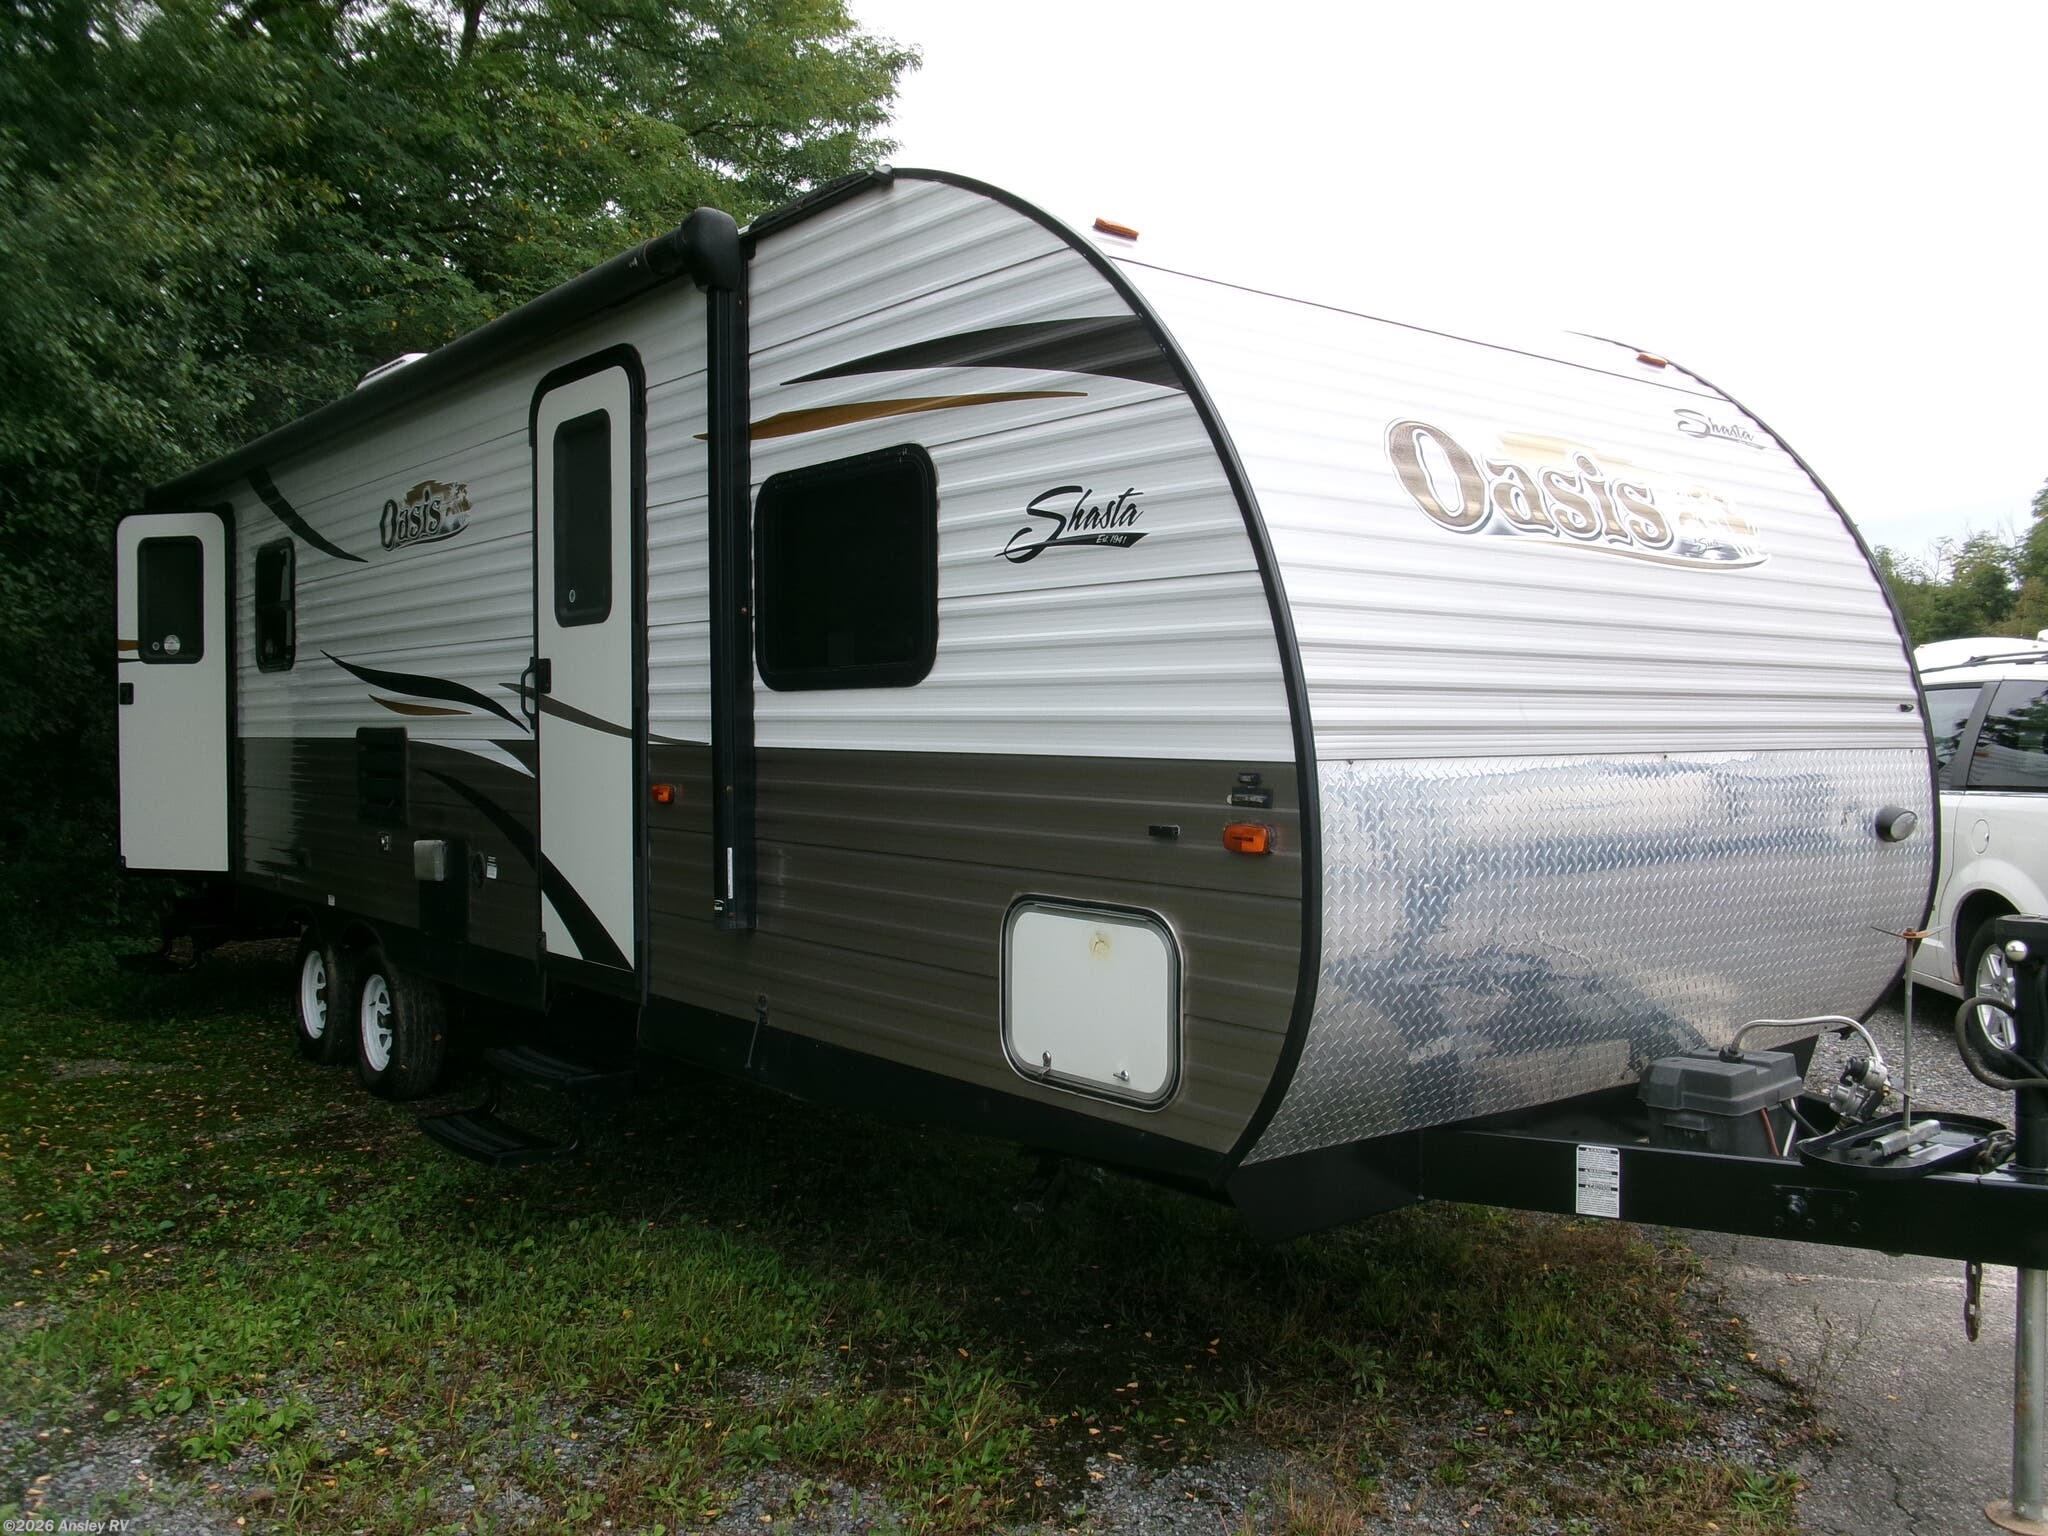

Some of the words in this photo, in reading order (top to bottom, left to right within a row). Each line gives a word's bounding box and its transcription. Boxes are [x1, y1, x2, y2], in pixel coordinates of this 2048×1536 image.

[1673, 408, 1755, 442] Shasta
[379, 485, 441, 552] Oasis
[1385, 418, 1676, 552] Oasis
[994, 485, 1145, 564] Shasta
